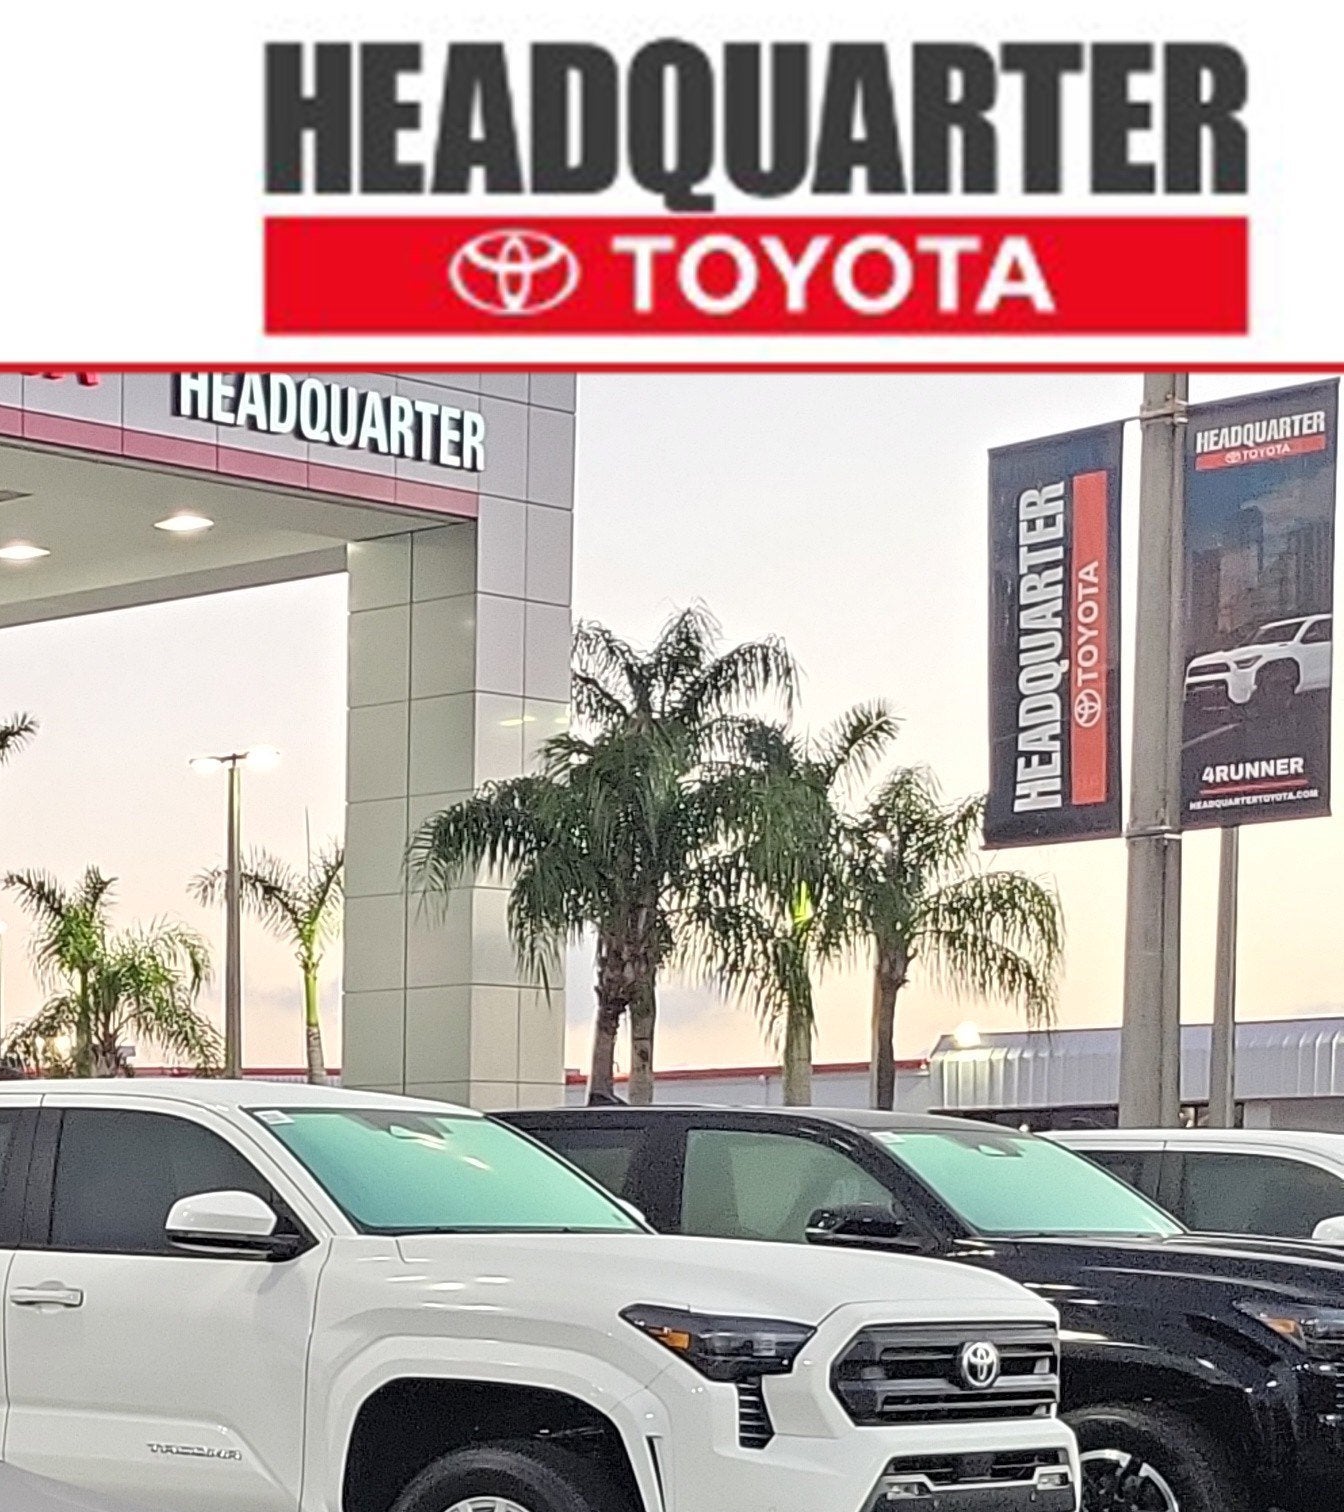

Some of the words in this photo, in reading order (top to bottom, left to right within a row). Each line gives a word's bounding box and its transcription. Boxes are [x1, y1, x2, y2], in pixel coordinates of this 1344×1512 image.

[178, 372, 486, 472] HEADQUARTER
[1196, 411, 1325, 453] HEADQUARTER
[1242, 443, 1291, 461] TOYOTA
[1076, 560, 1100, 687] TOYOTA
[1013, 481, 1068, 812] HEADQUARTER
[1201, 757, 1304, 783] 4RUNNER
[1189, 789, 1319, 811] HEADQUARTERTOYOTA.COM
